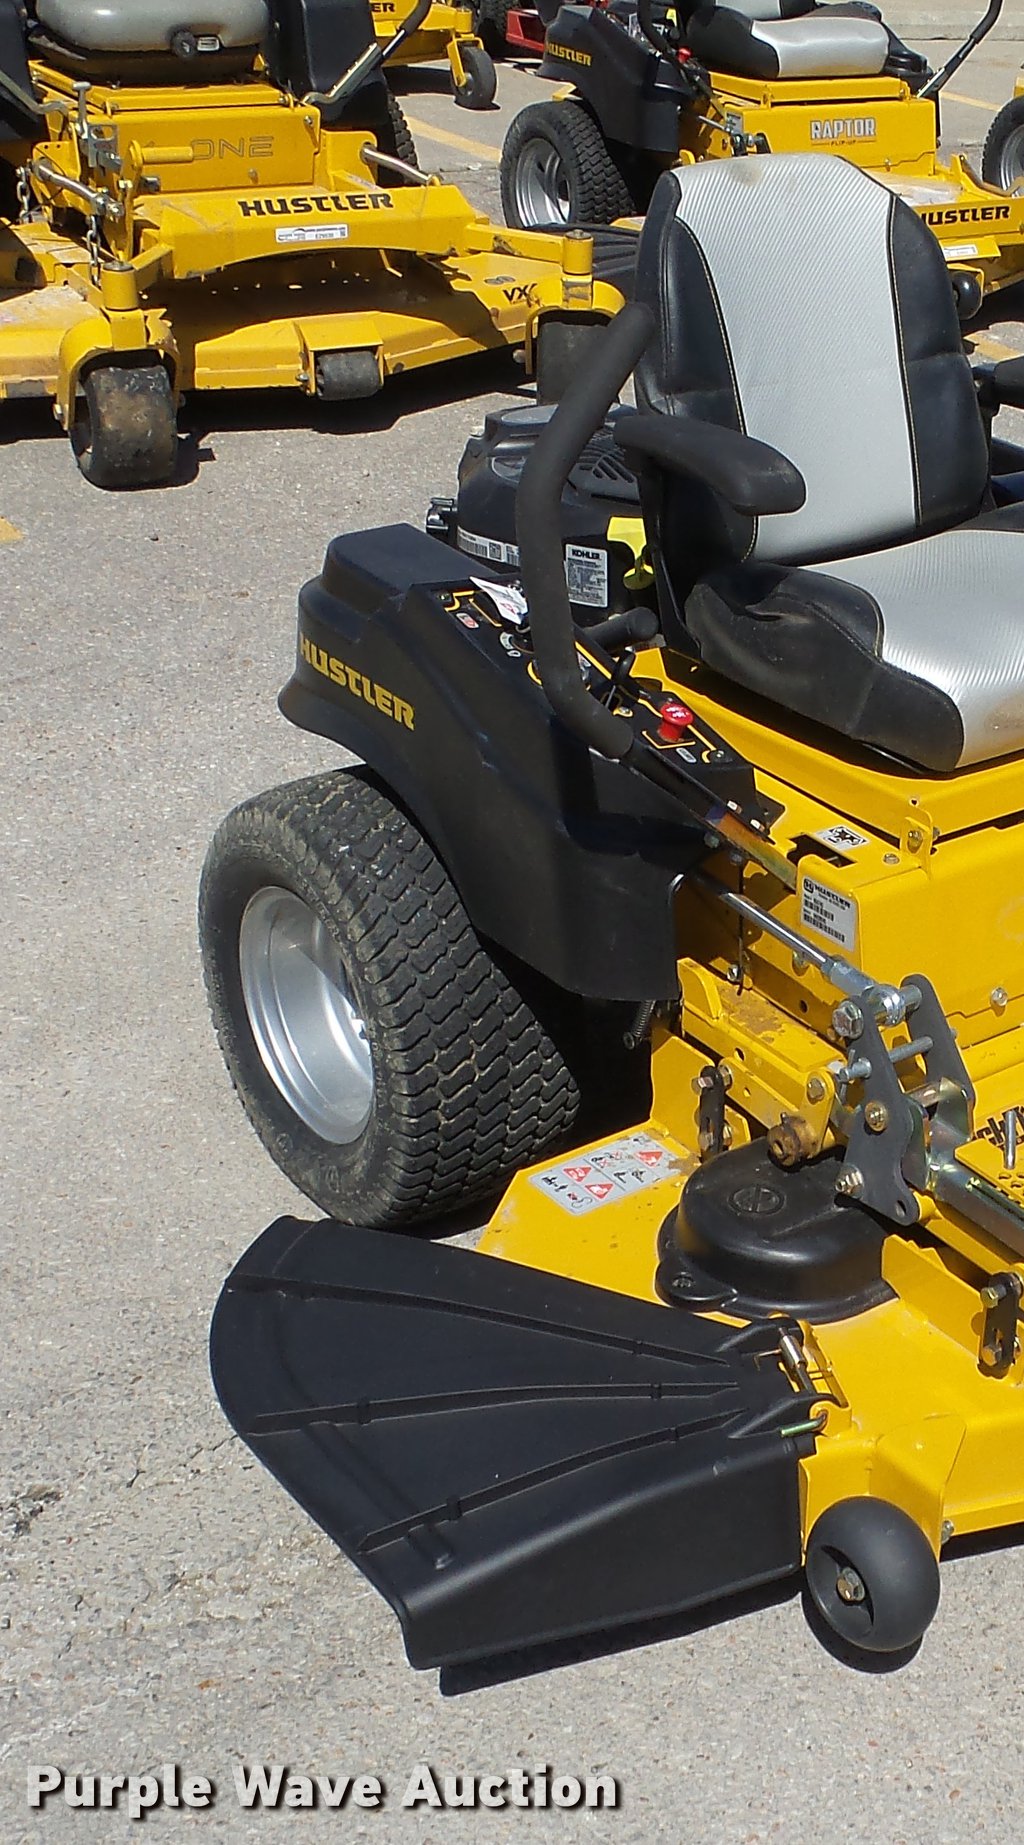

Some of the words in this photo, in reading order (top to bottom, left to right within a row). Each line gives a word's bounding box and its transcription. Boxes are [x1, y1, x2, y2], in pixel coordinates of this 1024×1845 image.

[810, 118, 876, 140] RAPTOR
[238, 192, 394, 218] HUSTLER
[571, 549, 601, 560] KOHLER
[299, 631, 416, 731] HUSTLER
[814, 884, 851, 909] HUSTLER
